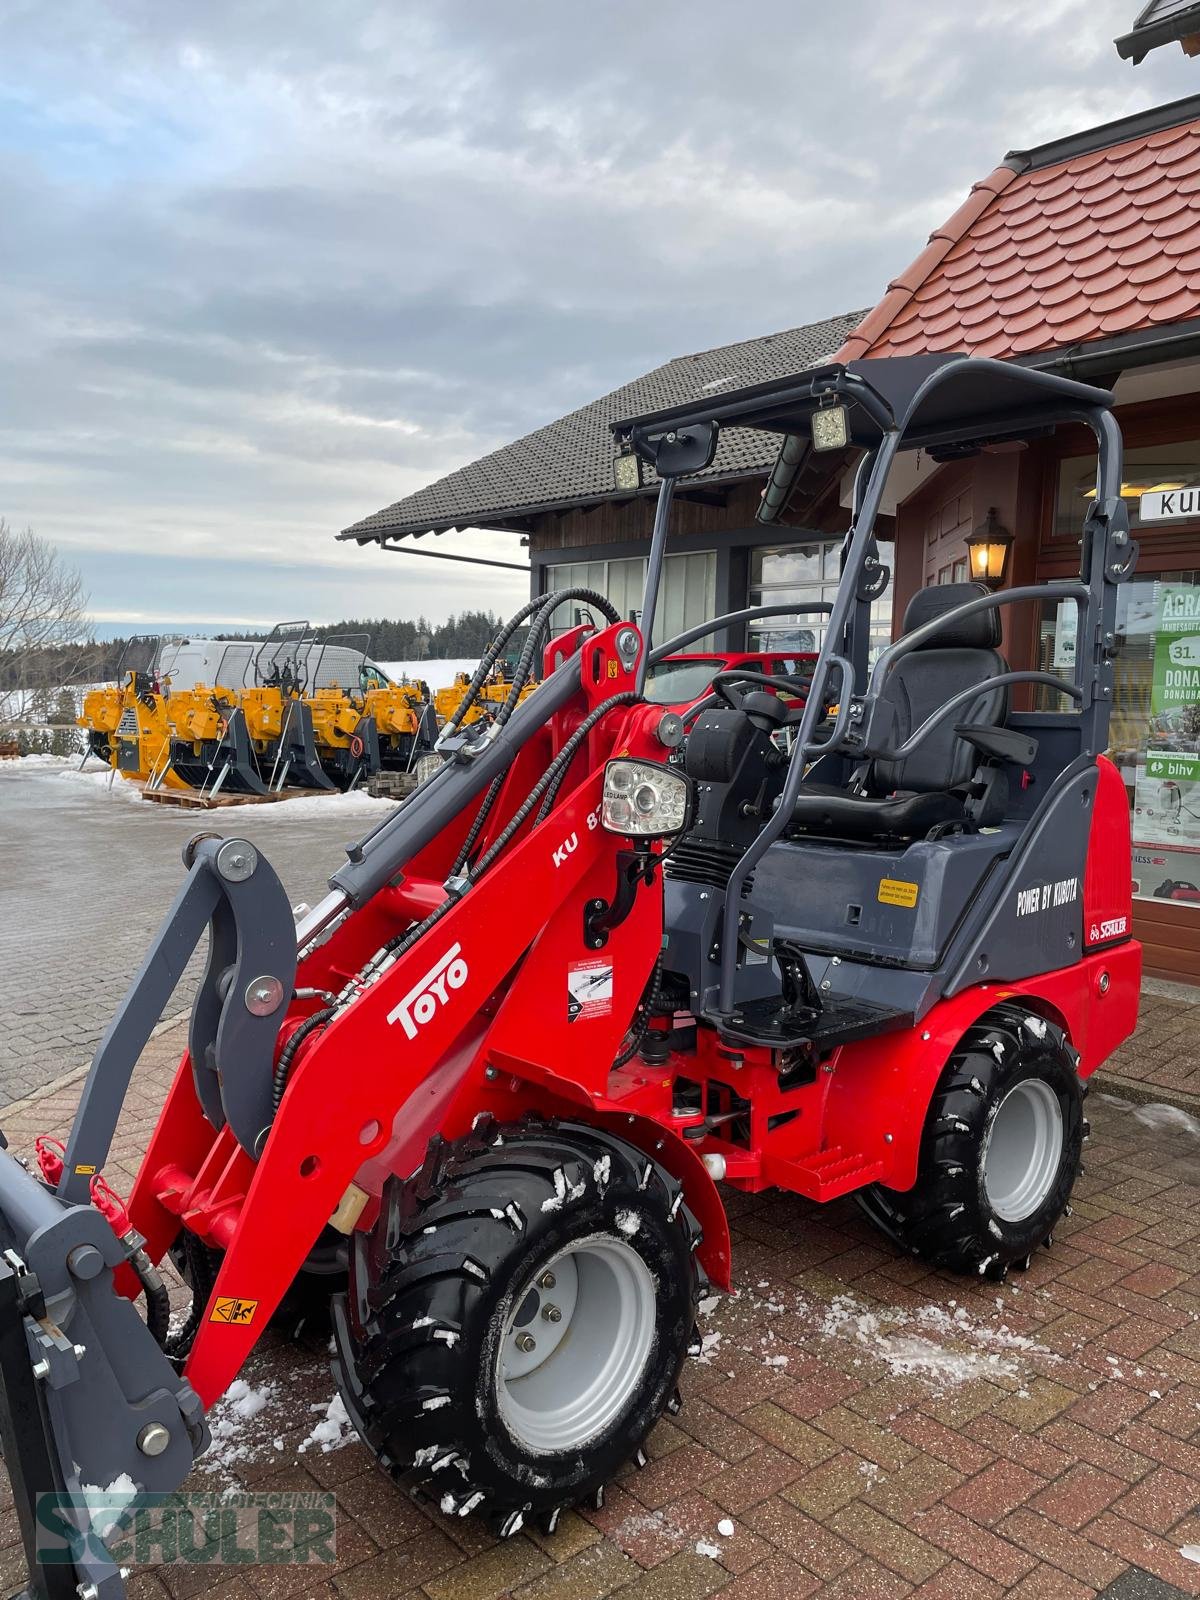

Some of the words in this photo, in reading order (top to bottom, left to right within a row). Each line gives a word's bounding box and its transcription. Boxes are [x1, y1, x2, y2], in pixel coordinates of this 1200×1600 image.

[1161, 490, 1200, 515] KU
[1165, 669, 1200, 687] DONA
[1168, 762, 1193, 776] blhv
[552, 831, 578, 868] KU
[1016, 887, 1041, 918] POWER
[1042, 884, 1053, 910] BY
[1053, 877, 1078, 907] KUBOTA
